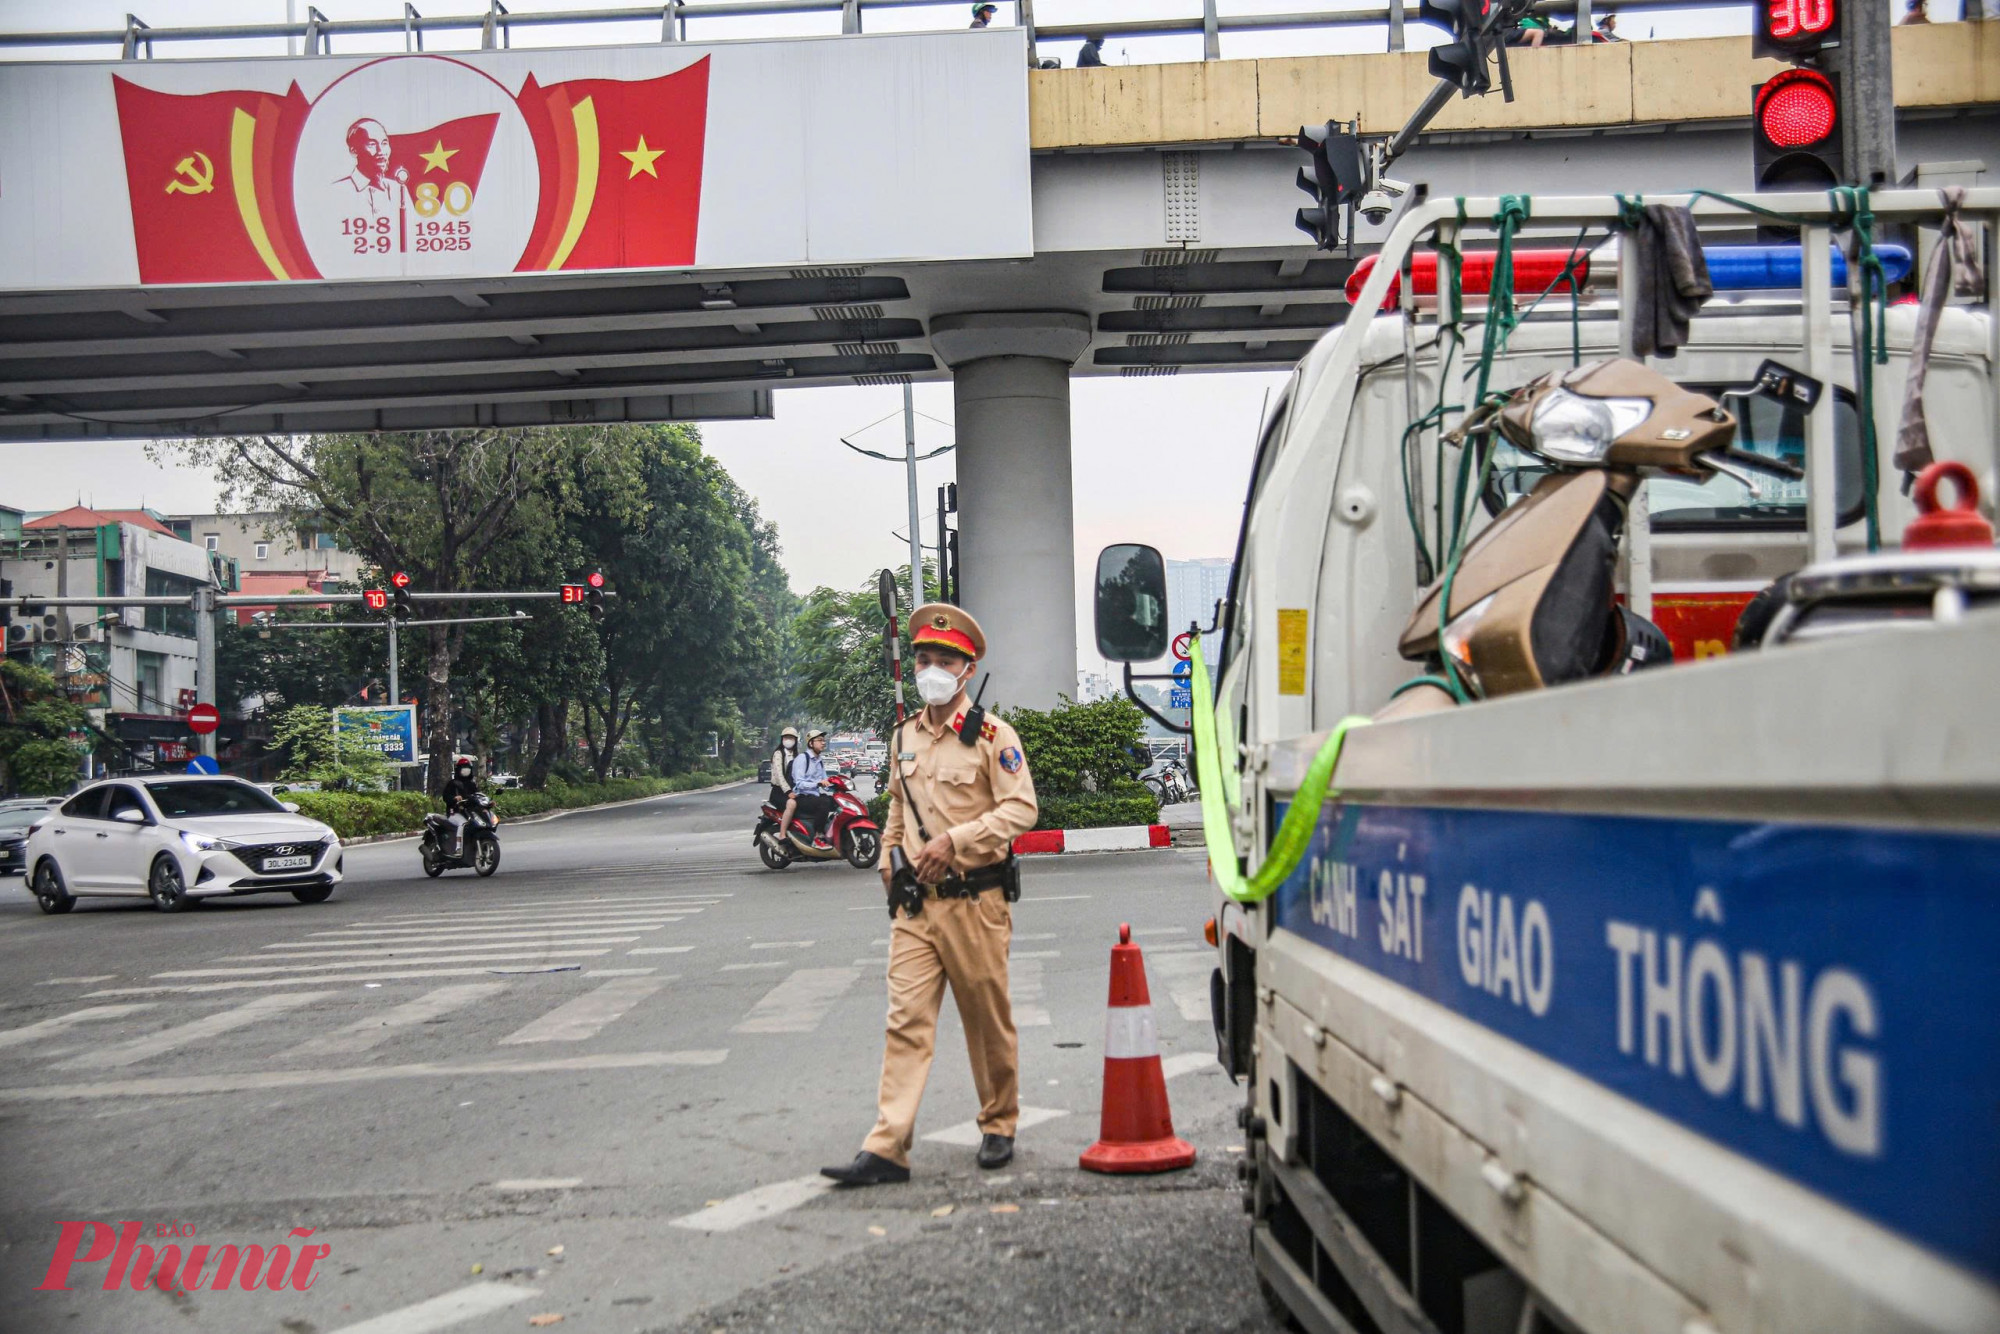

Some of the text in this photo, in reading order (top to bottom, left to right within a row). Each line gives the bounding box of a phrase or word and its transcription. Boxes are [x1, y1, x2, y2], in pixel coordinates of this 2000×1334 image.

[415, 181, 473, 218] 80
[341, 216, 391, 236] 19-8
[415, 221, 472, 236] 1945
[353, 235, 391, 255] 2-9
[415, 236, 472, 252] 2025
[367, 593, 385, 608] 70
[564, 587, 582, 602] 31
[1310, 826, 1879, 1160] CẢNH SÁT GIAO THÔNG
